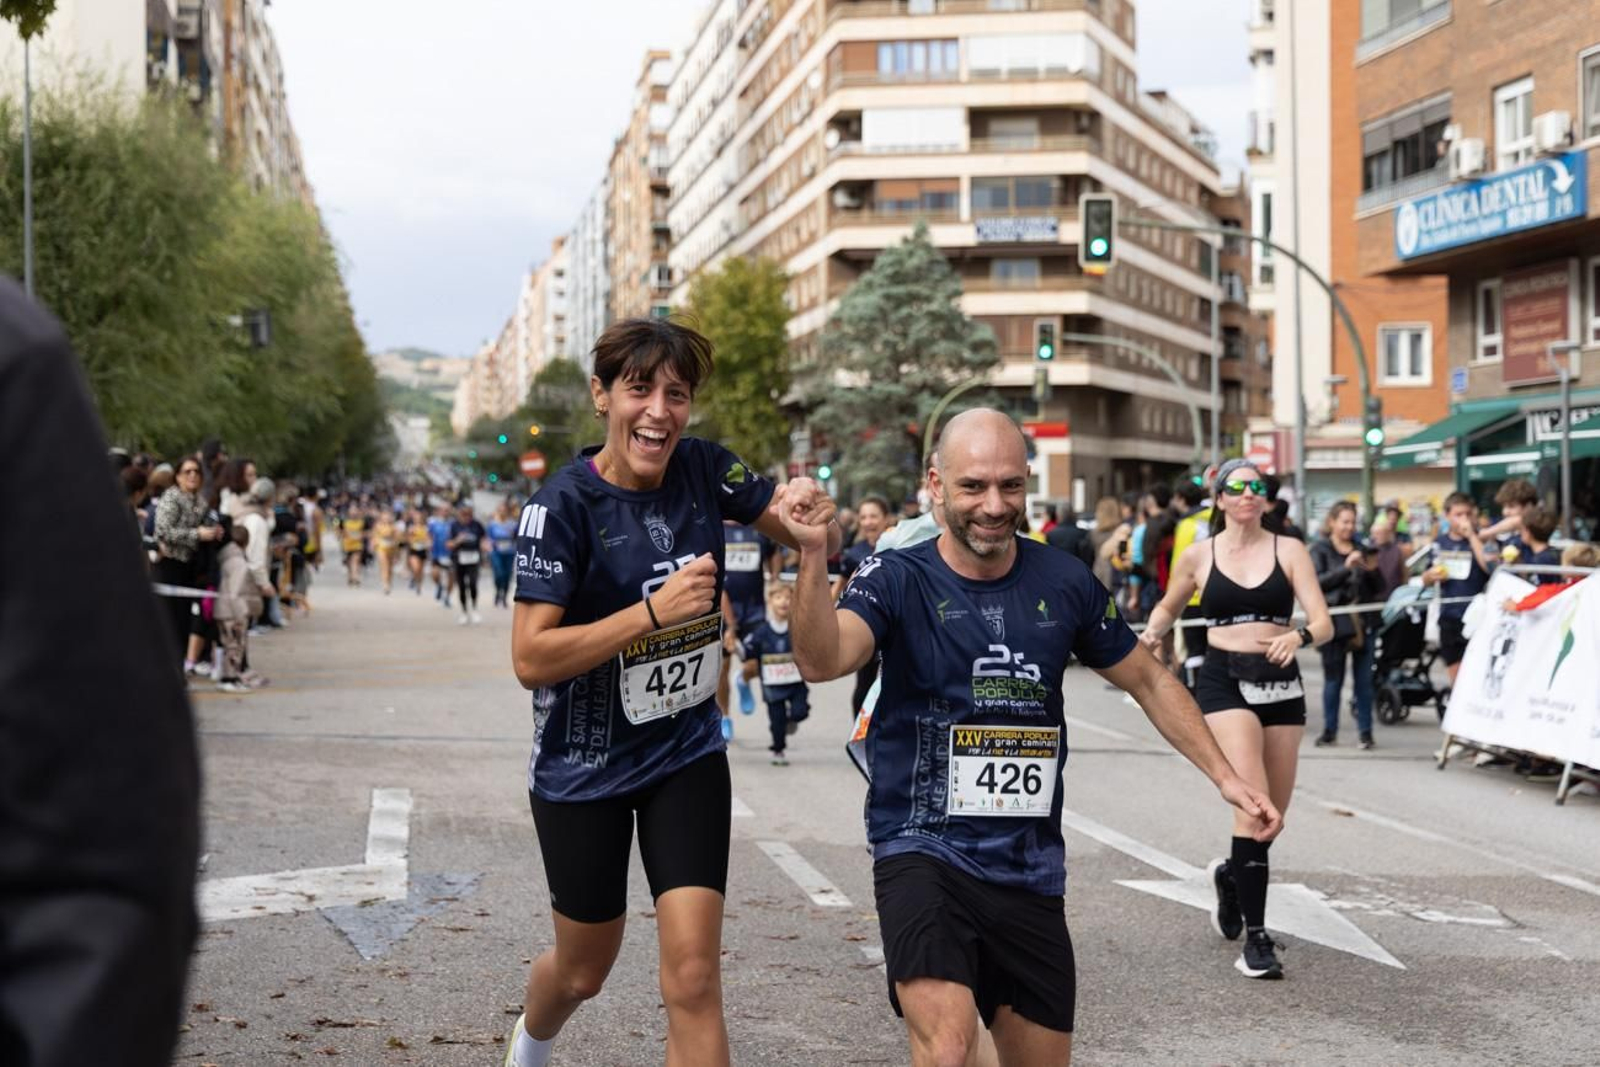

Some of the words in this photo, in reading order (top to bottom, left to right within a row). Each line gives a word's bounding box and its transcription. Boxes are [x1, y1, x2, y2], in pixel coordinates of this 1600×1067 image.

[1481, 168, 1549, 215] DENTAL
[649, 629, 686, 644] CARRERA
[659, 638, 681, 650] gran
[626, 637, 648, 659] XXV
[973, 644, 1041, 682] 25
[646, 652, 705, 697] 427
[572, 701, 589, 744] SANTA
[590, 726, 605, 748] DE
[956, 730, 983, 746] XXV
[984, 731, 1024, 740] CARRERA
[983, 739, 990, 747] y
[994, 739, 1018, 747] gran
[976, 762, 1042, 795] 426
